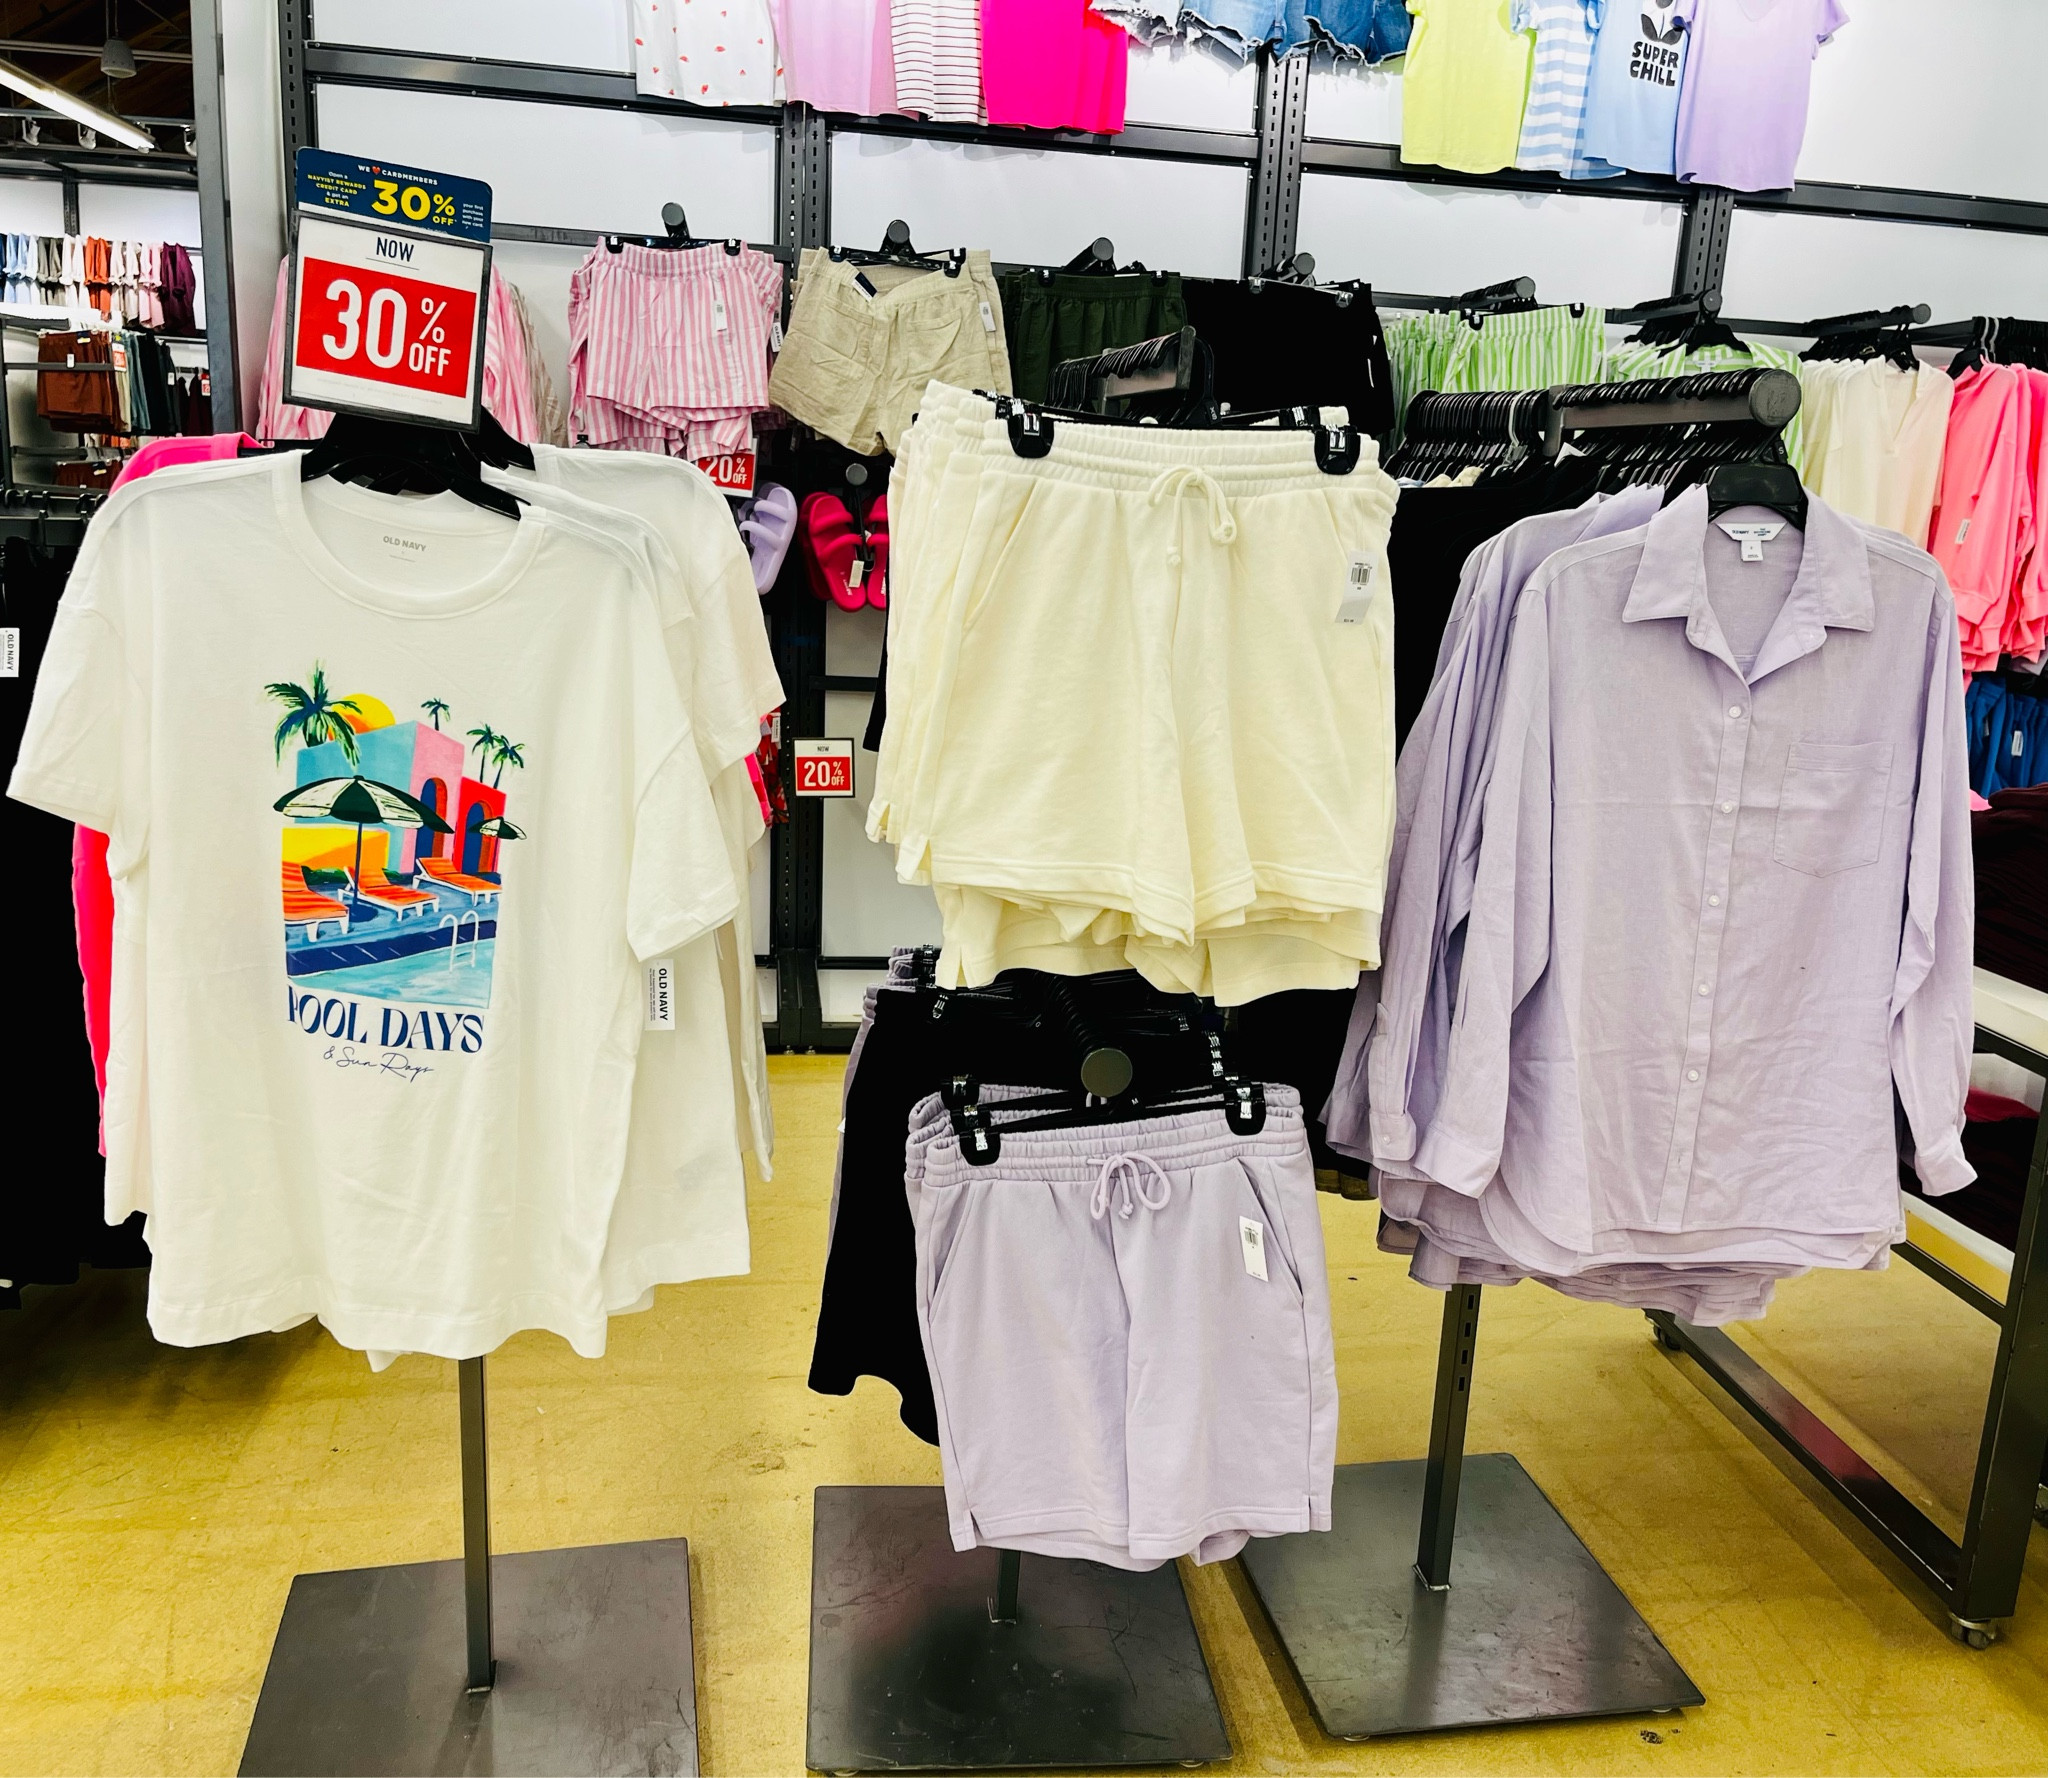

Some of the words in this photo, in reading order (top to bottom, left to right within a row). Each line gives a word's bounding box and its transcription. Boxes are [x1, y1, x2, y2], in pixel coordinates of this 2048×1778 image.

[1632, 41, 1679, 68] SUPER
[1630, 60, 1675, 86] CHILL
[335, 179, 366, 190] REWARDS
[358, 164, 370, 173] WE
[382, 169, 438, 186] CARDMEMBERS
[316, 183, 339, 191] CREDIT
[340, 187, 358, 195] CARD
[325, 196, 350, 207] EXTRA
[376, 237, 414, 262] NOW
[408, 342, 451, 377] OFF
[732, 472, 747, 484] OFF
[383, 535, 401, 546] OLD
[402, 540, 426, 551] NAVY
[831, 776, 845, 786] OFF
[659, 968, 667, 989] OLD
[659, 991, 668, 1021] NAVY
[287, 984, 368, 1044] POOL
[379, 1007, 484, 1053] DAYS
[323, 1045, 333, 1060] &
[336, 1046, 378, 1068] Sun
[380, 1052, 435, 1083] Rays
